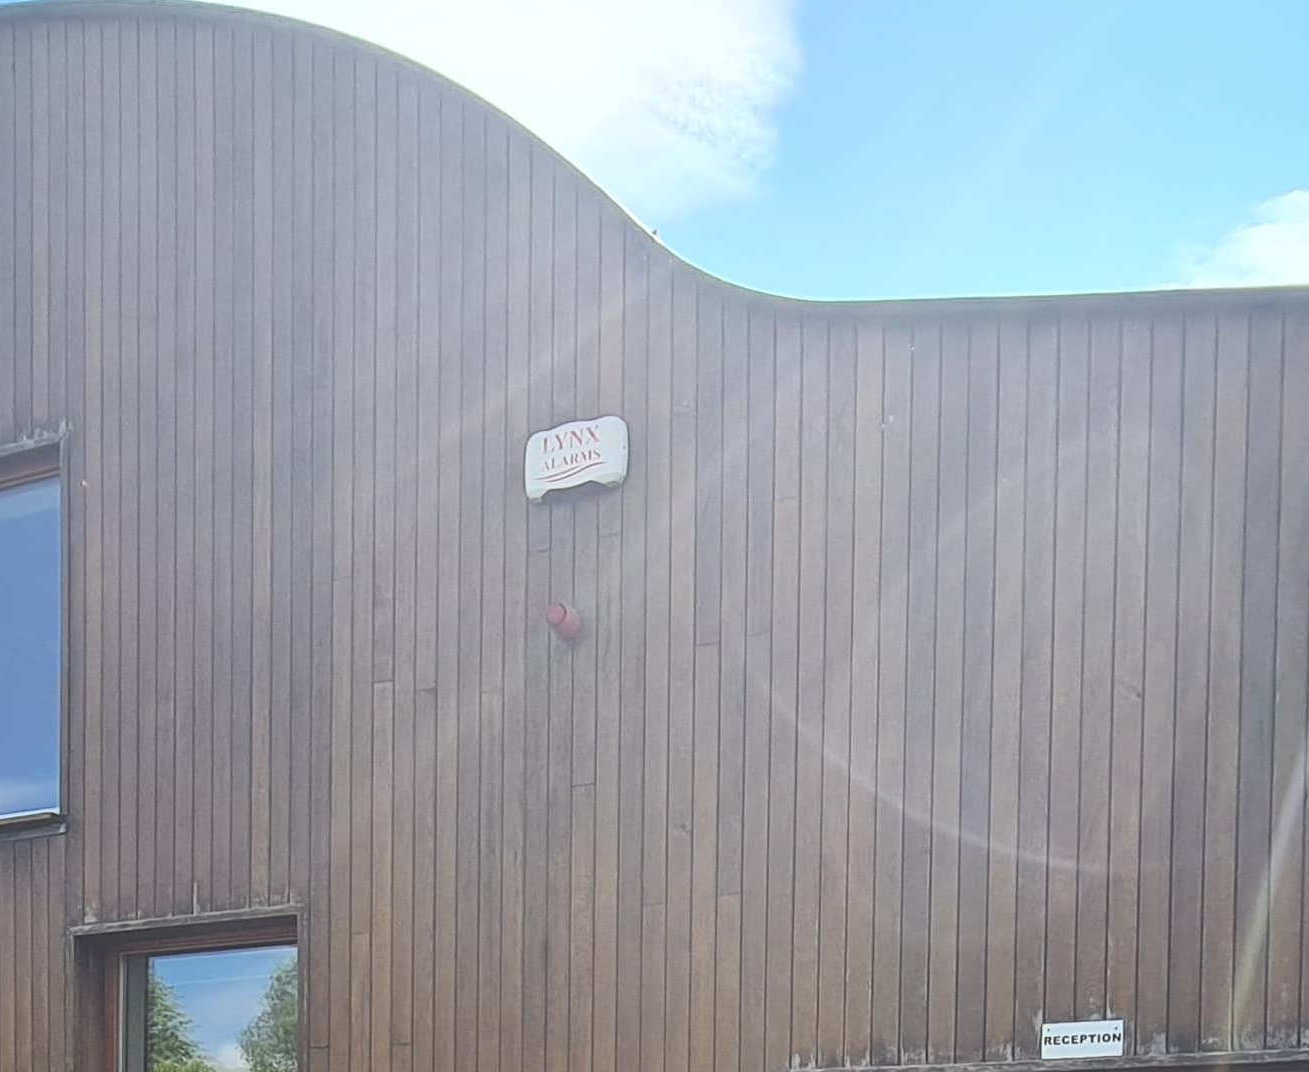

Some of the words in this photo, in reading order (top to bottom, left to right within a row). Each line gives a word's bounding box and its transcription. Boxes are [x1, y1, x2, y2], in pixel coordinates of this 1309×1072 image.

[542, 425, 600, 454] LYNX
[542, 449, 601, 471] ALARMS
[1044, 1033, 1122, 1046] RECEPTION
